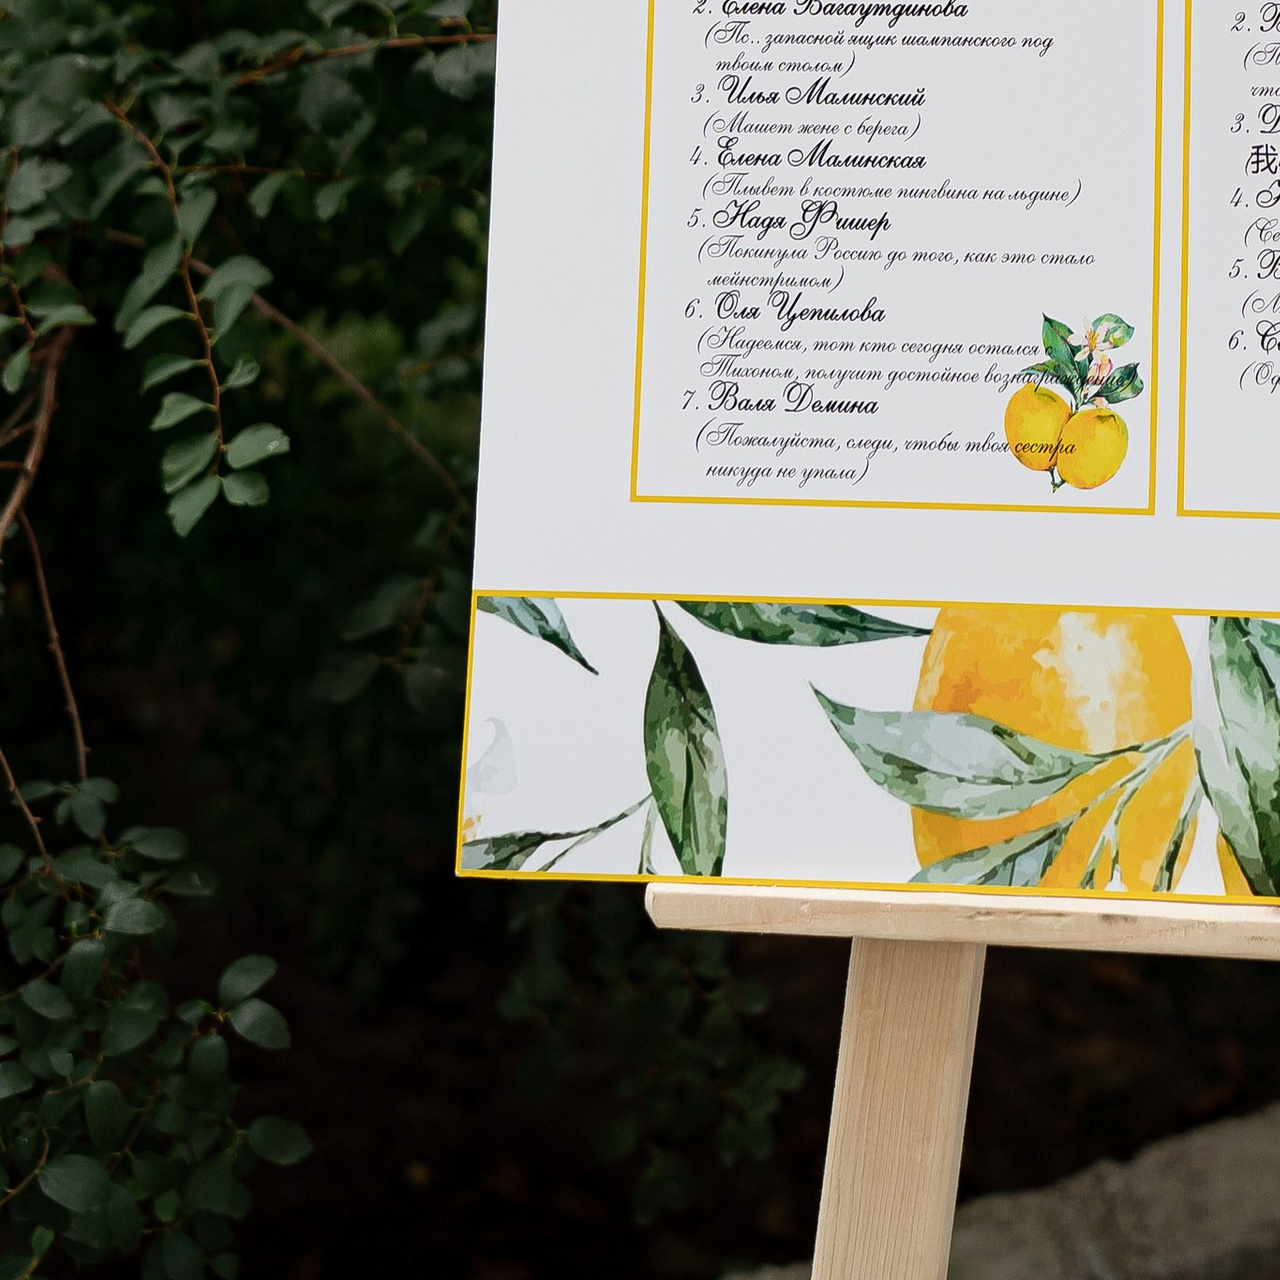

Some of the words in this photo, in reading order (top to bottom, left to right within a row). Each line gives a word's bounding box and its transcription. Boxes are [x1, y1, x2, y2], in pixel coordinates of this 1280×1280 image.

[690, 83, 710, 104] 3.
[716, 73, 781, 105] Илья
[784, 75, 927, 107] Малинский
[797, 123, 840, 135] жене
[843, 124, 853, 135] с
[1230, 112, 1250, 134] 3.
[686, 207, 706, 228] 5.
[712, 198, 788, 241] Надя
[788, 198, 892, 242] Фишер
[1228, 258, 1248, 279] 5.
[681, 389, 699, 411] 7.
[707, 379, 777, 412] Валя
[782, 377, 880, 415] Демина
